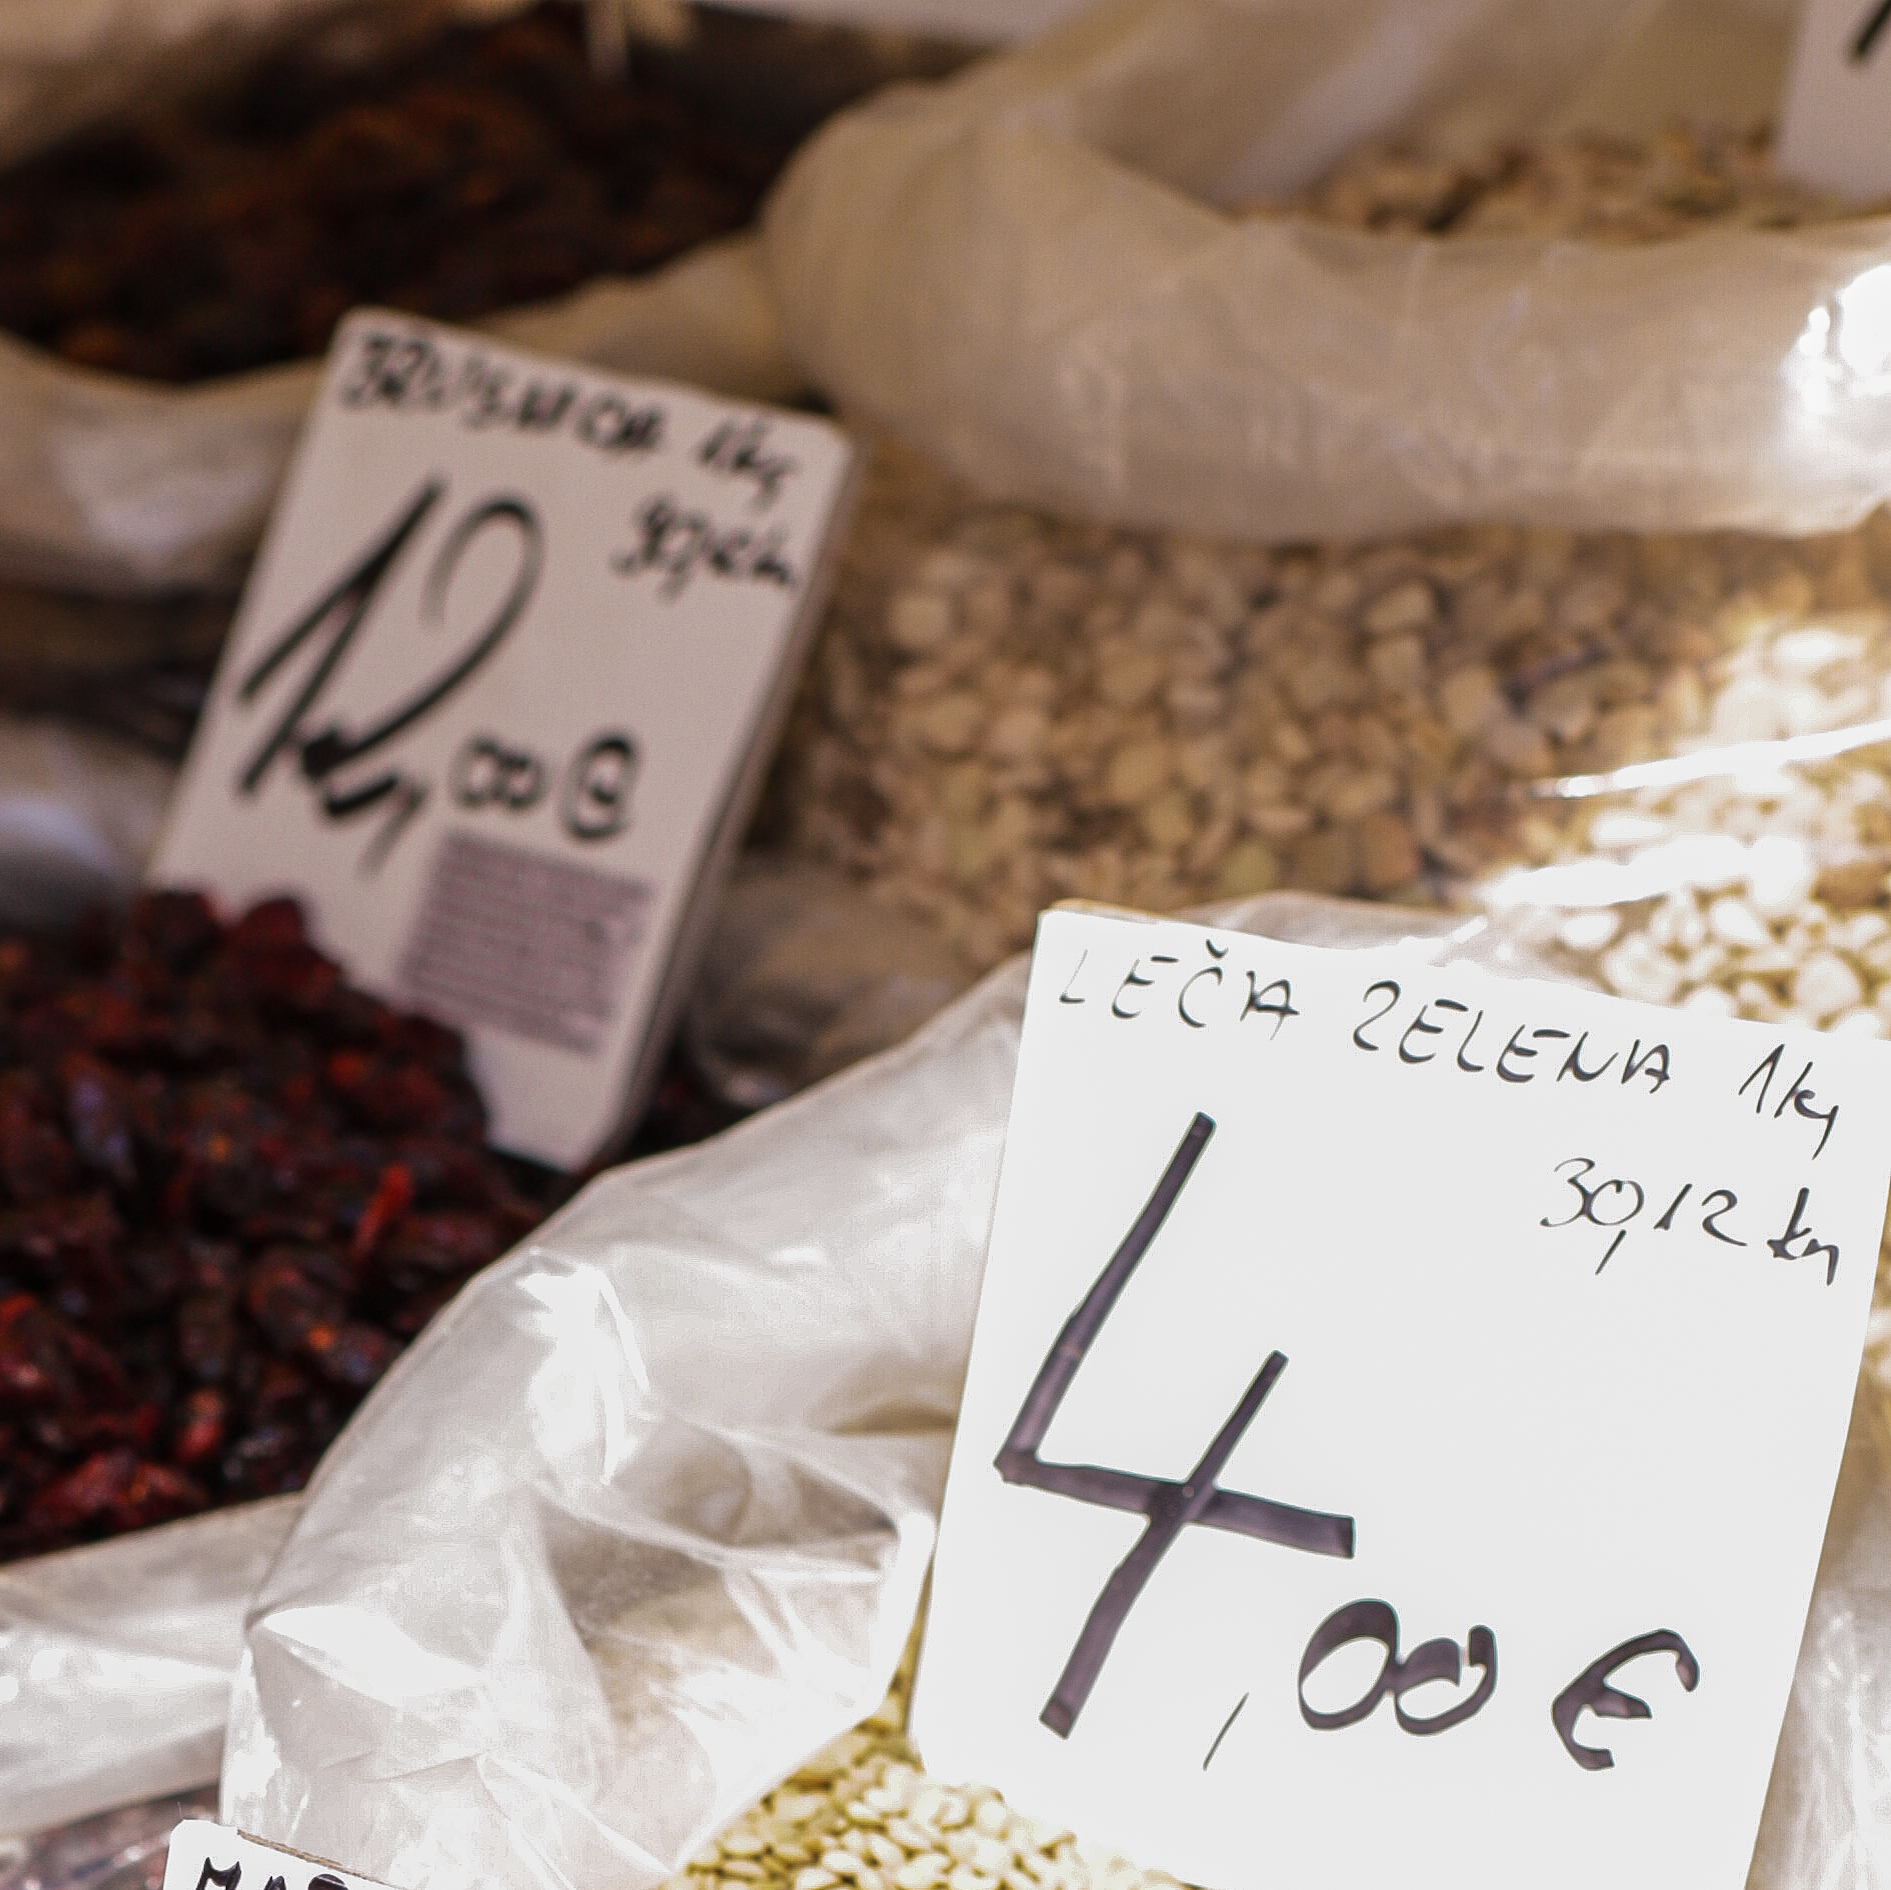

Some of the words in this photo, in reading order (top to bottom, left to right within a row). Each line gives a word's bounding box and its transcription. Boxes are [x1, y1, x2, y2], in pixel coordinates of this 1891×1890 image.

[1059, 938, 1299, 1040] LEČA
[1353, 979, 1671, 1094] ZELENA
[1737, 1043, 1840, 1160] 1kg
[1539, 1156, 1748, 1275] 30,12
[1766, 1187, 1840, 1287] kn
[993, 1112, 1498, 1771] 4,00
[1551, 1628, 1701, 1772] €
